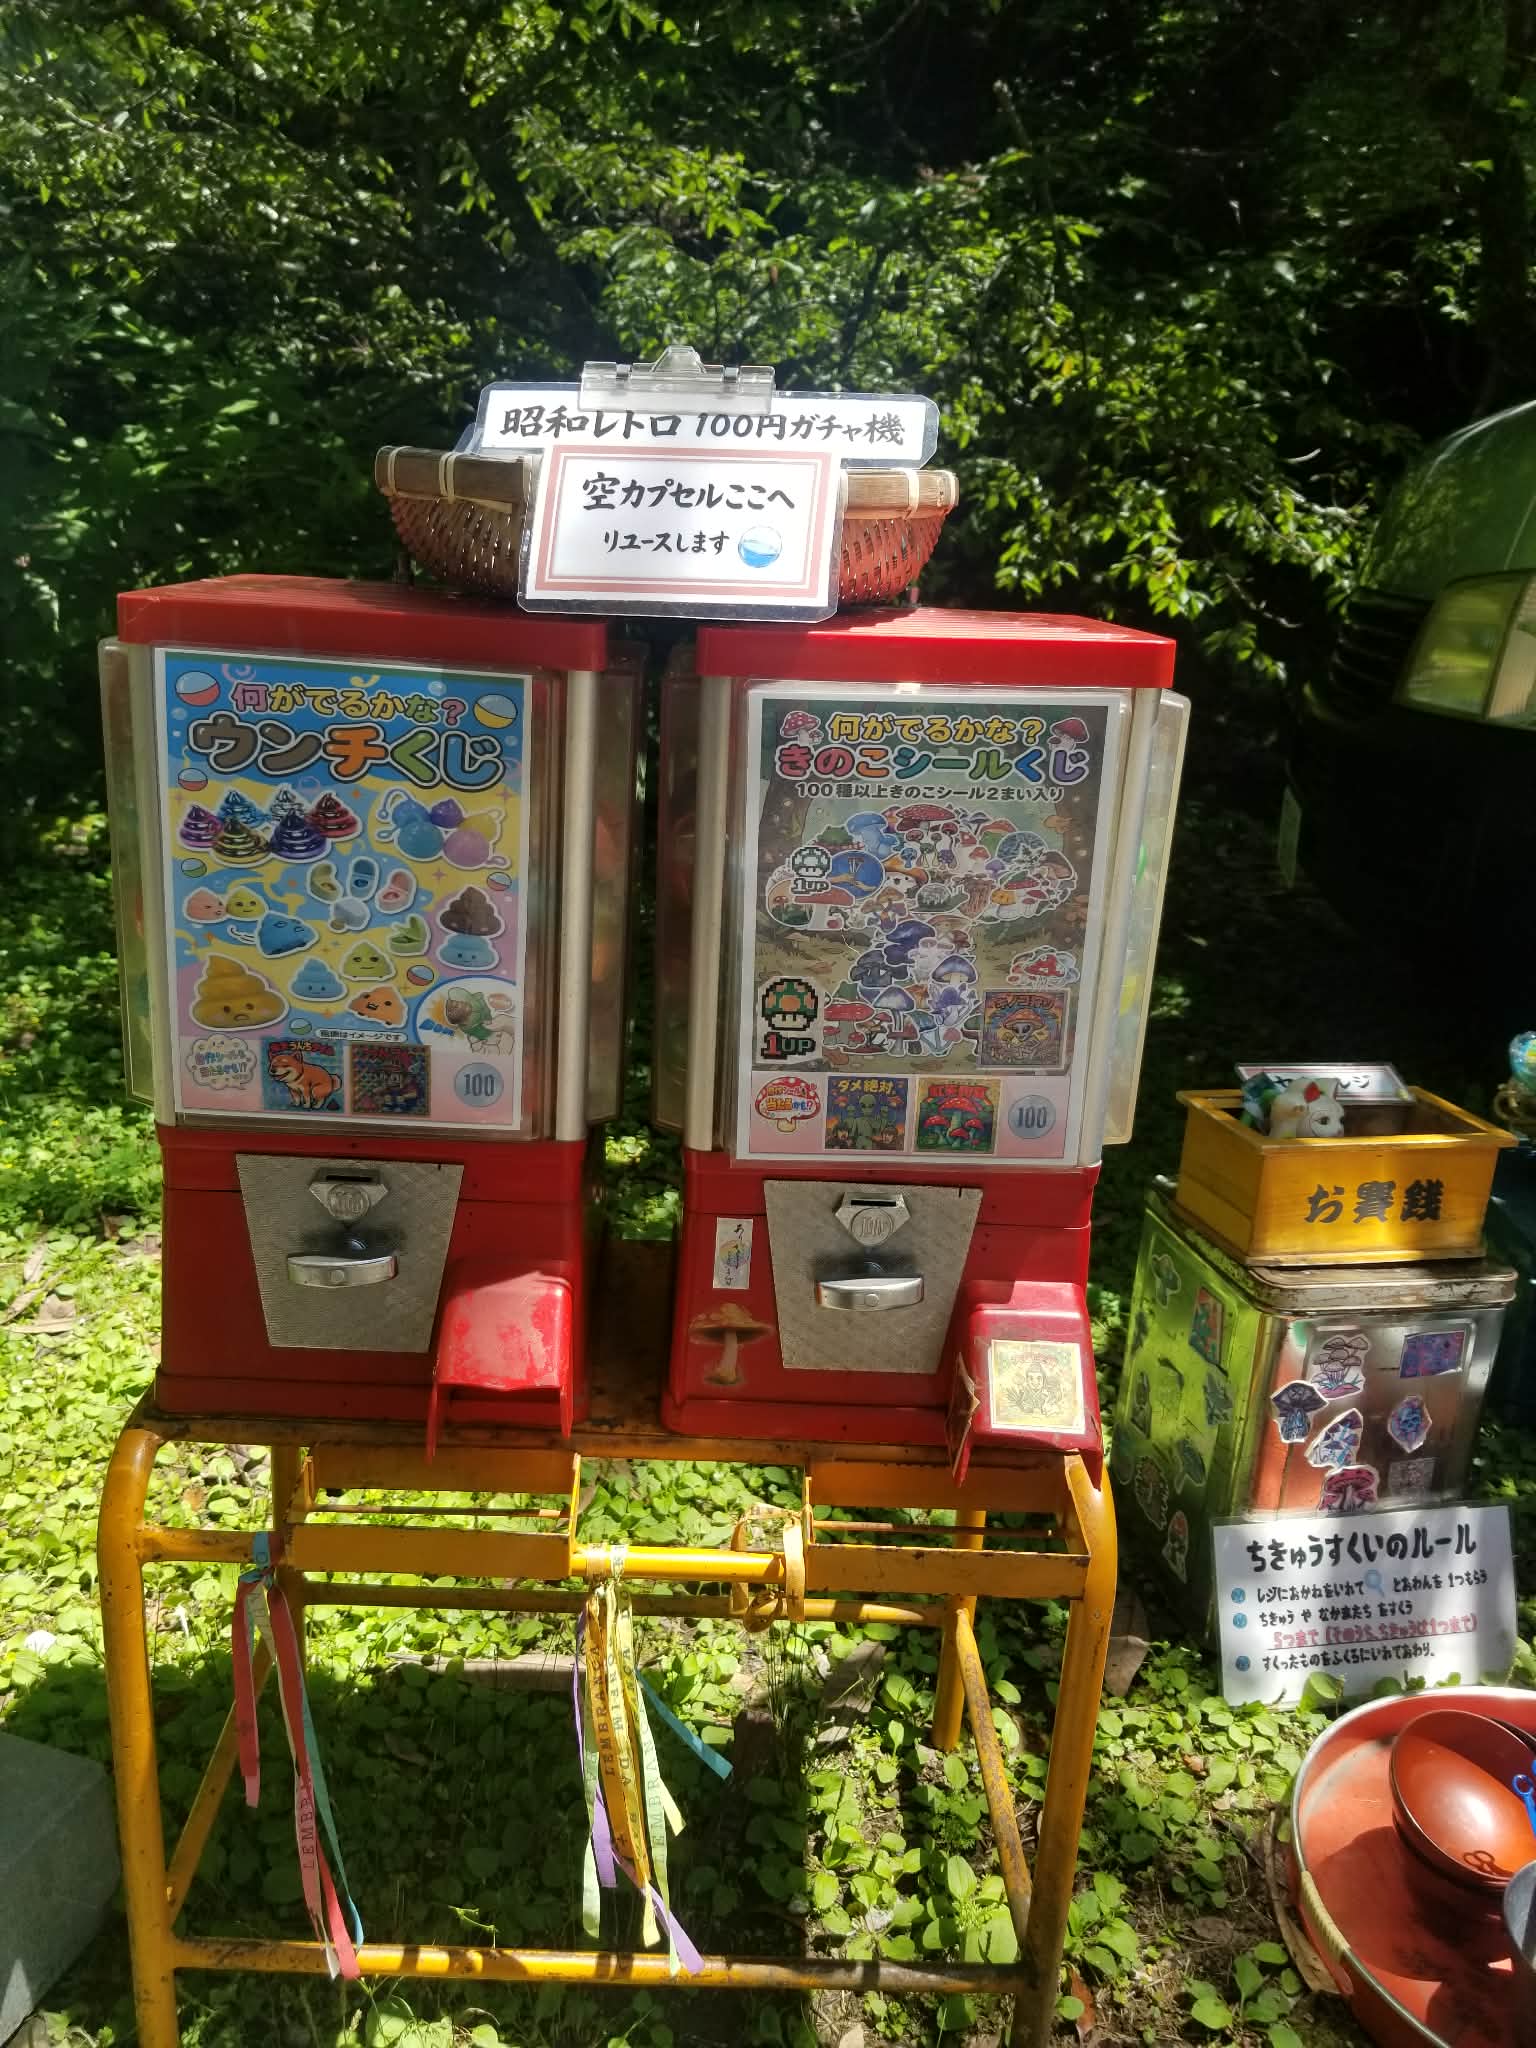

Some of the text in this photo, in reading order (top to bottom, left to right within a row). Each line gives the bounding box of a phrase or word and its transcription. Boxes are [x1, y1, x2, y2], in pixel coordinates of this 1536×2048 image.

[500, 405, 905, 446] 昭和レトロ 100円ガチャ機
[582, 471, 795, 512] 空カプセルここへ
[603, 528, 730, 555] リユースします
[231, 682, 467, 726] 何がでるかな?
[828, 714, 1045, 744] 何がでるかな?
[189, 710, 505, 791] ウンチくじ
[776, 744, 1088, 785] きのこシールくじ
[761, 1031, 816, 1060] 1UP
[463, 1072, 497, 1098] 100
[1015, 1105, 1047, 1129] 100
[1246, 1523, 1477, 1573] ちきゅうすくいのルール
